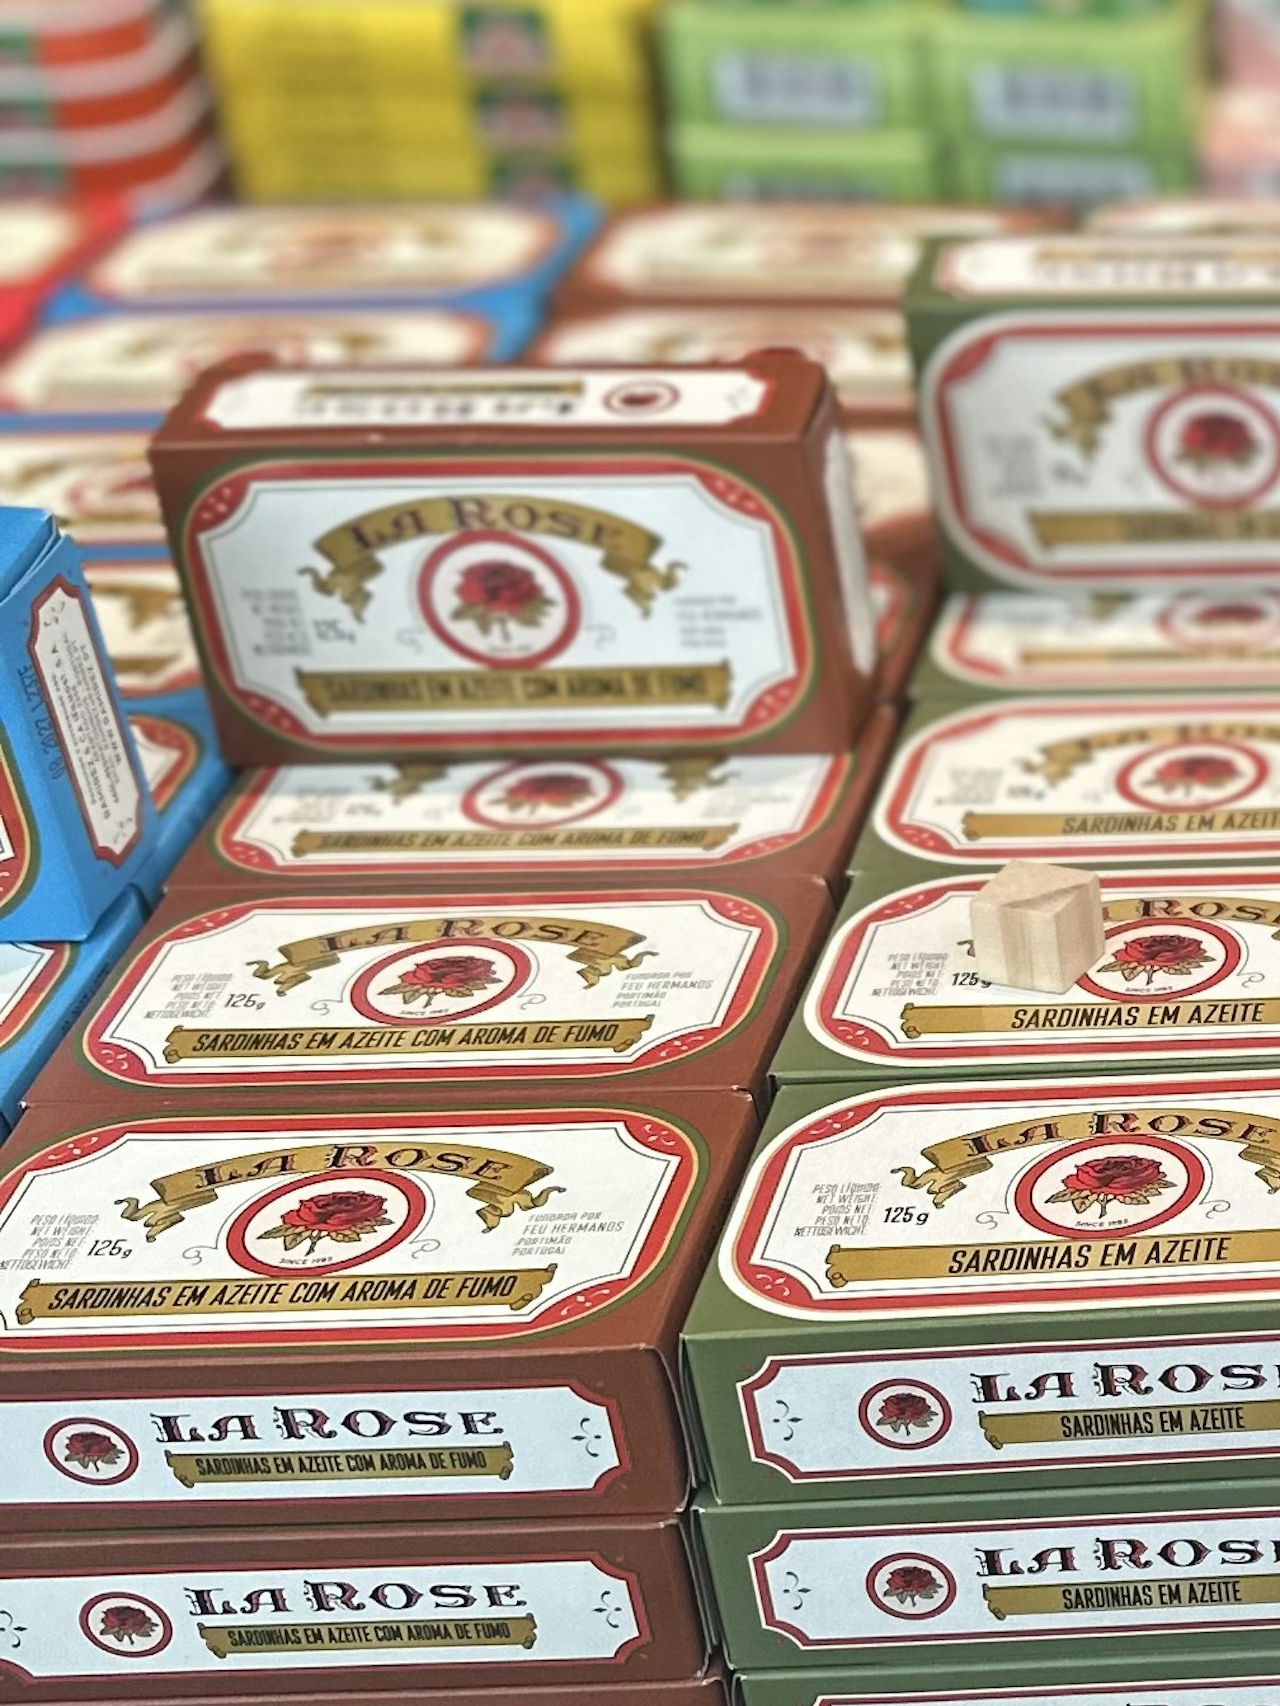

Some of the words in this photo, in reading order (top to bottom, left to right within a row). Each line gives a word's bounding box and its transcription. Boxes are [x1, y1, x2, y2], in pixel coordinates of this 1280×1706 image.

[353, 513, 427, 549] LA
[451, 497, 626, 543] ROSE
[319, 924, 403, 952] LA
[437, 918, 602, 948] ROSE
[1010, 1005, 1141, 1030] SARDINHAS
[1148, 1005, 1181, 1026] EM
[1188, 1002, 1263, 1024] AZEITE
[966, 1120, 1059, 1157] LA
[1088, 1112, 1279, 1145] ROSE
[198, 1152, 298, 1189] LA
[330, 1144, 513, 1182] ROSE
[948, 1246, 1090, 1274] SARDINHAS
[1100, 1246, 1137, 1268] EM
[1144, 1239, 1230, 1264] AZEITE
[48, 1285, 167, 1311] SARDINHAS
[174, 1285, 205, 1307] EM
[211, 1282, 282, 1306] AZEITE
[289, 1281, 335, 1304] COM
[341, 1278, 416, 1301] AROMA
[427, 1277, 448, 1299] DE
[457, 1275, 518, 1298] FUMO
[971, 1371, 1080, 1403] LA
[150, 1409, 263, 1444] LA
[273, 1406, 504, 1441] ROSE
[1061, 1414, 1154, 1437] SARDINHAS
[1161, 1412, 1184, 1434] EM
[1190, 1410, 1245, 1432] AZEITE
[196, 1456, 270, 1476] SARDINHAS
[275, 1455, 294, 1473] EM
[299, 1454, 343, 1473] AZEITE
[348, 1454, 376, 1472] COM
[381, 1453, 424, 1471] AROMA
[430, 1452, 446, 1469] DE
[450, 1450, 487, 1469] FUMO
